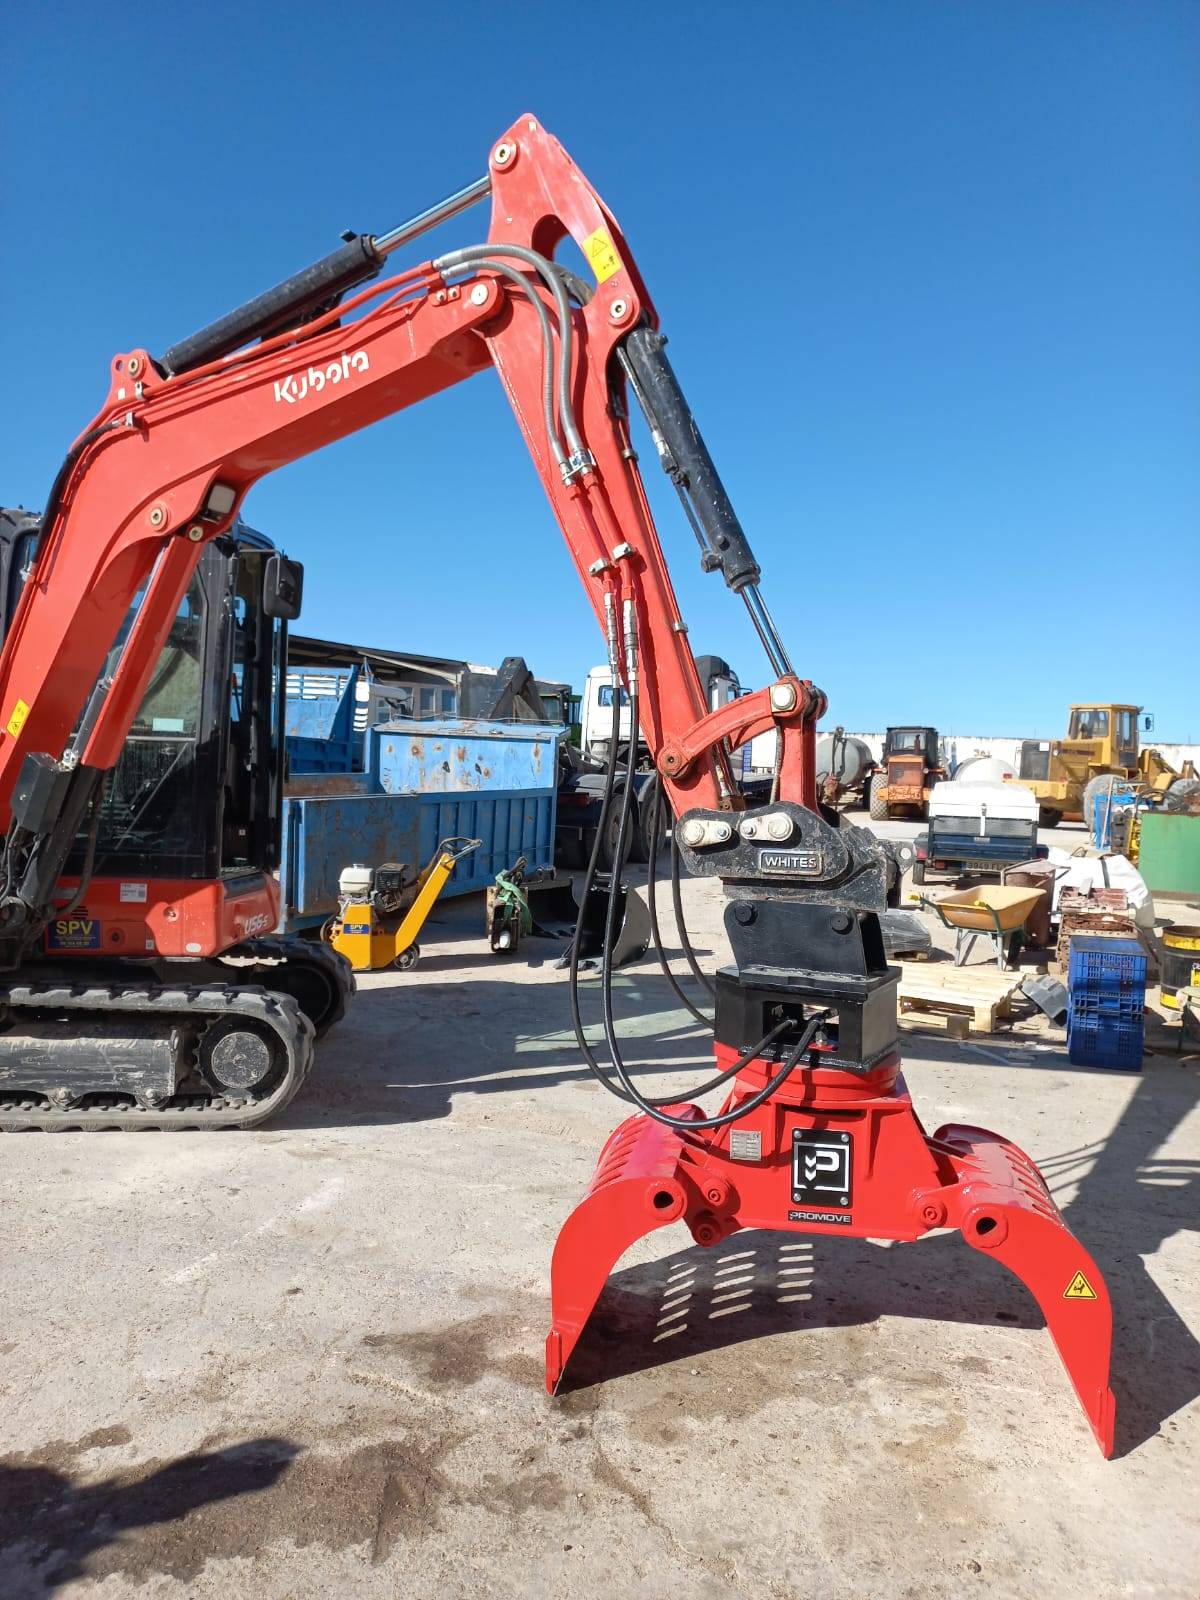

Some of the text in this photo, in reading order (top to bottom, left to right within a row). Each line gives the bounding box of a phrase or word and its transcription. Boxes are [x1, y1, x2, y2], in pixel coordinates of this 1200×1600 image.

[273, 350, 369, 404] Kubota
[765, 856, 817, 868] WHITES
[56, 920, 93, 935] SPV
[788, 1211, 852, 1224] PROMOVE
